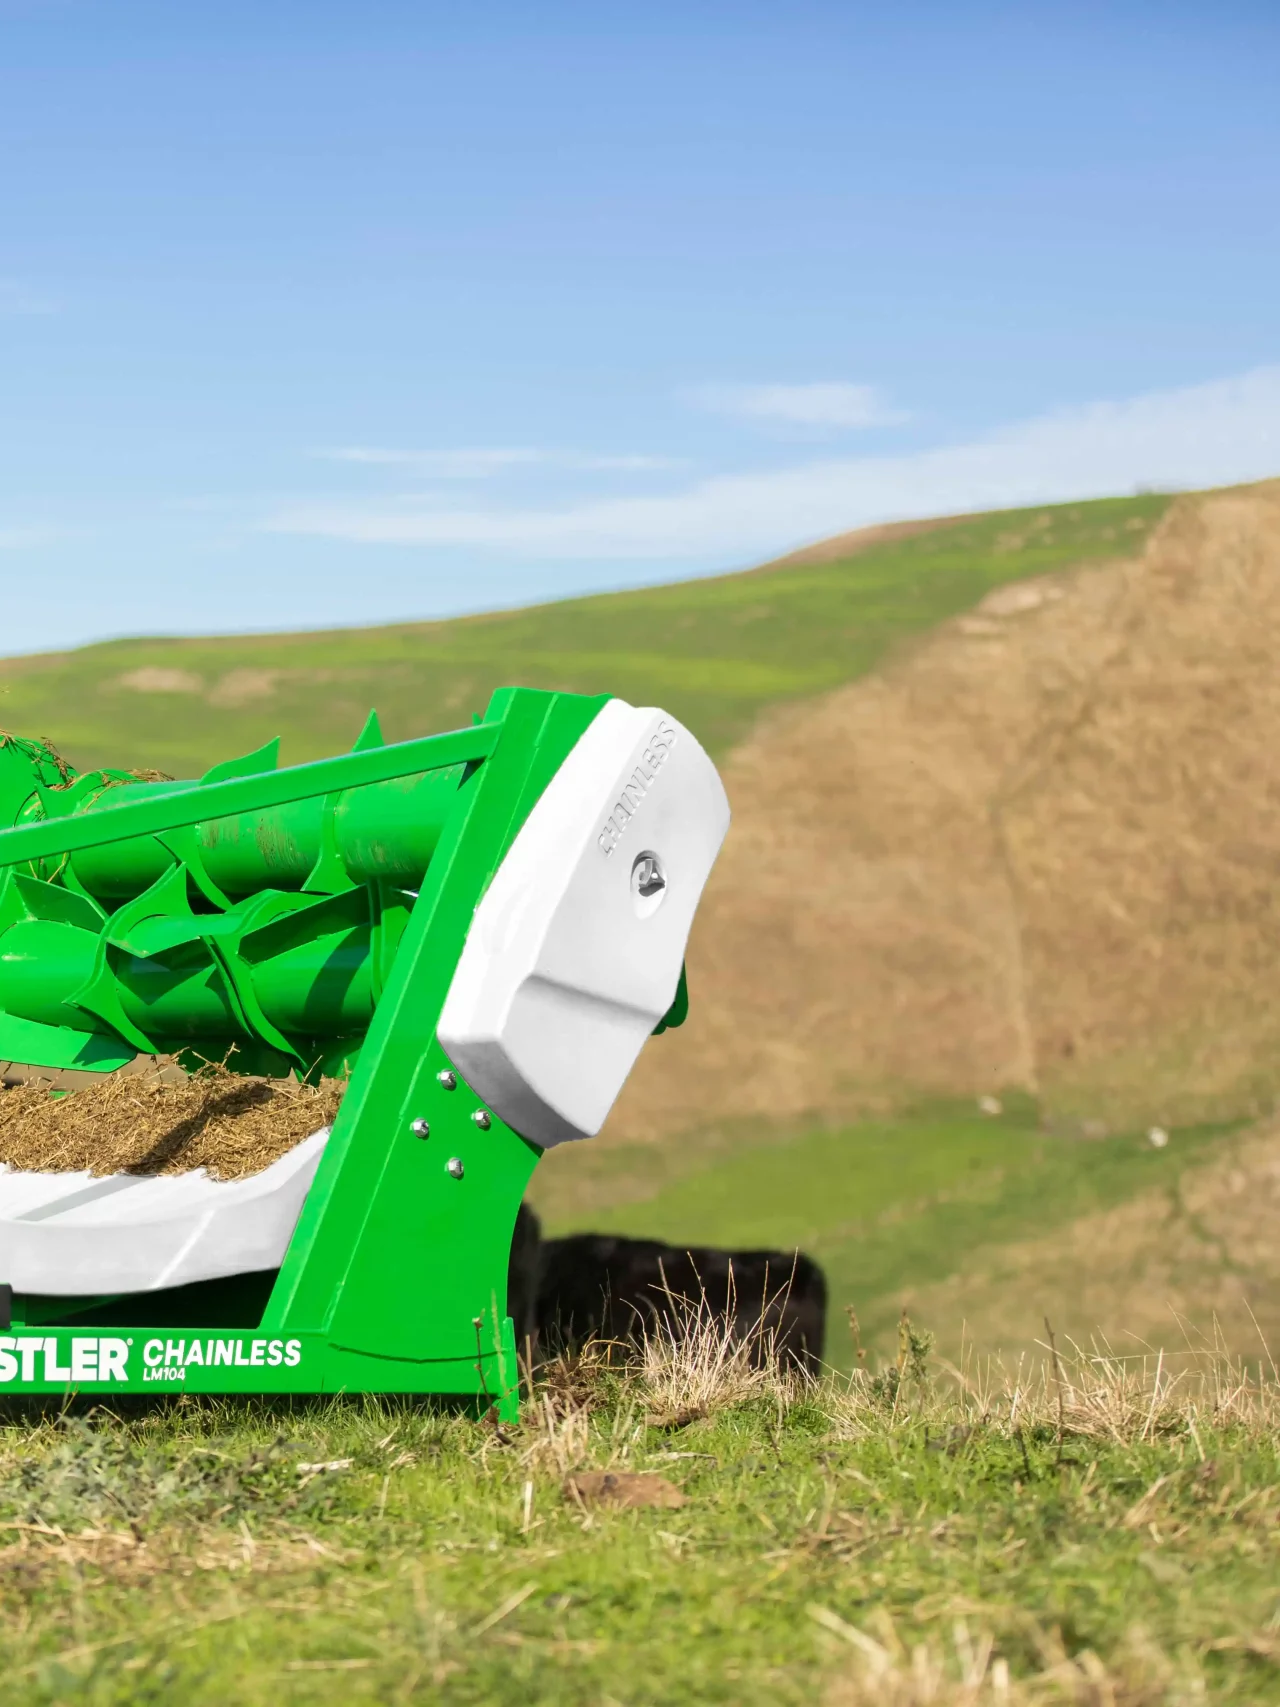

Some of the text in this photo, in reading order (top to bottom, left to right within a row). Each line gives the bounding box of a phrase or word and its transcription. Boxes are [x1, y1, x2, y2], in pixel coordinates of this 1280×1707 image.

[597, 720, 678, 859] CHAINLESS
[143, 1339, 302, 1366] CHAINLESS
[143, 1367, 186, 1381] LM104
